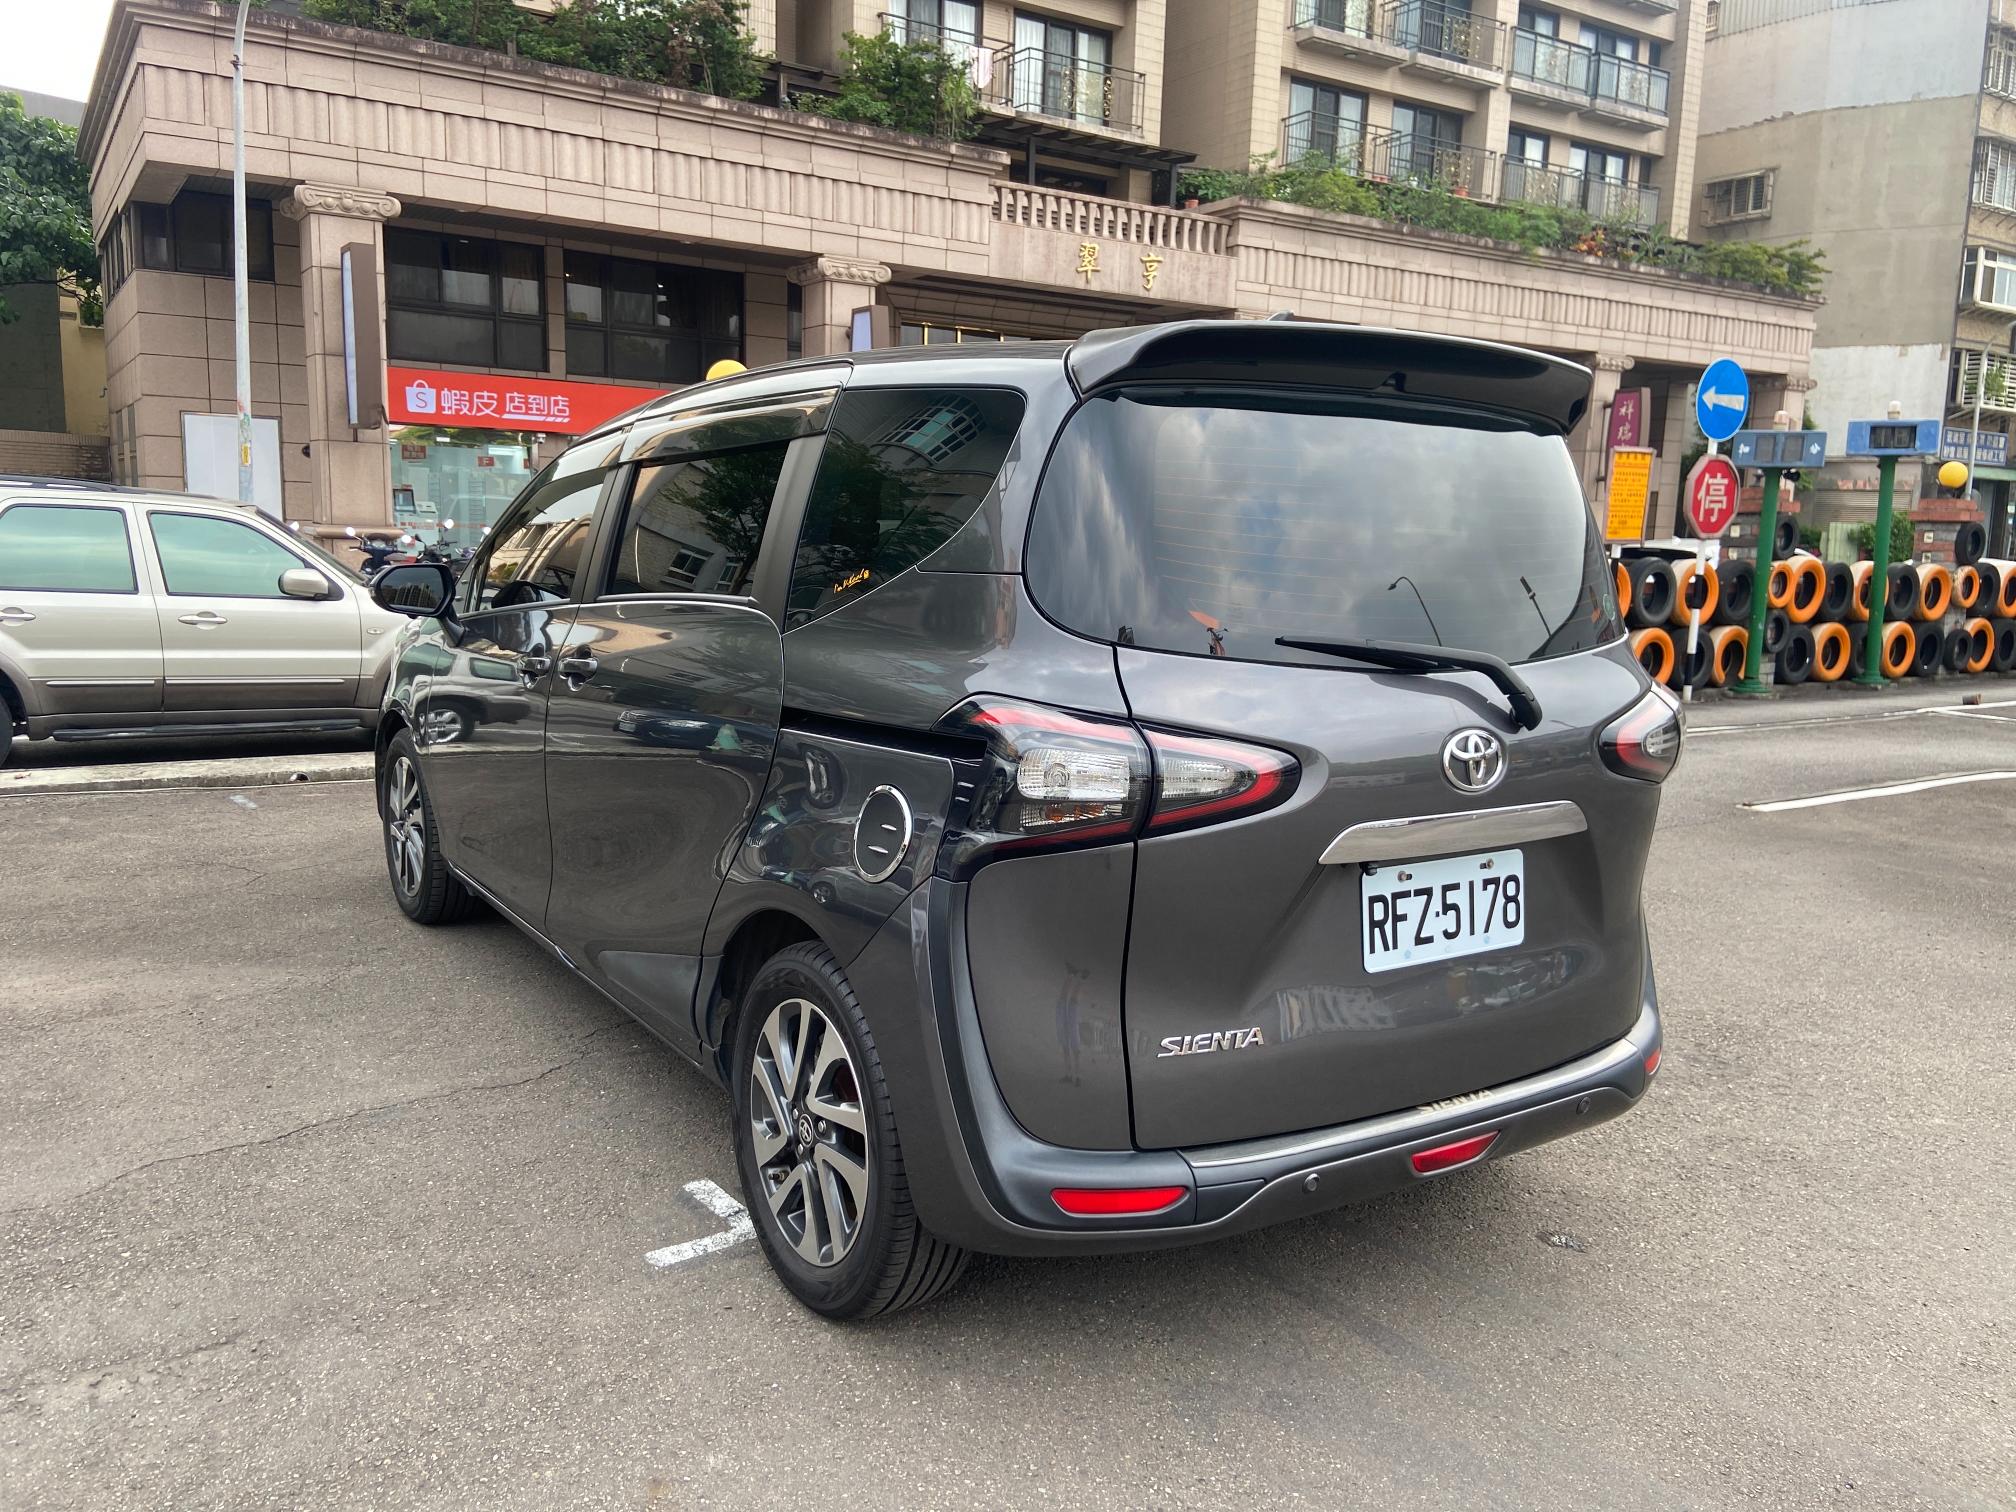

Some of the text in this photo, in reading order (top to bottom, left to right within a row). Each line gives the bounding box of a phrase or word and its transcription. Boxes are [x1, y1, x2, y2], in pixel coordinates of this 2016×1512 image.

[441, 387, 570, 417] 蝦皮 店到店
[1617, 399, 1635, 447] 祥瑞
[1697, 472, 1729, 523] 停
[1368, 874, 1520, 955] RFZ-5178
[1157, 1027, 1264, 1058] SIENTA
